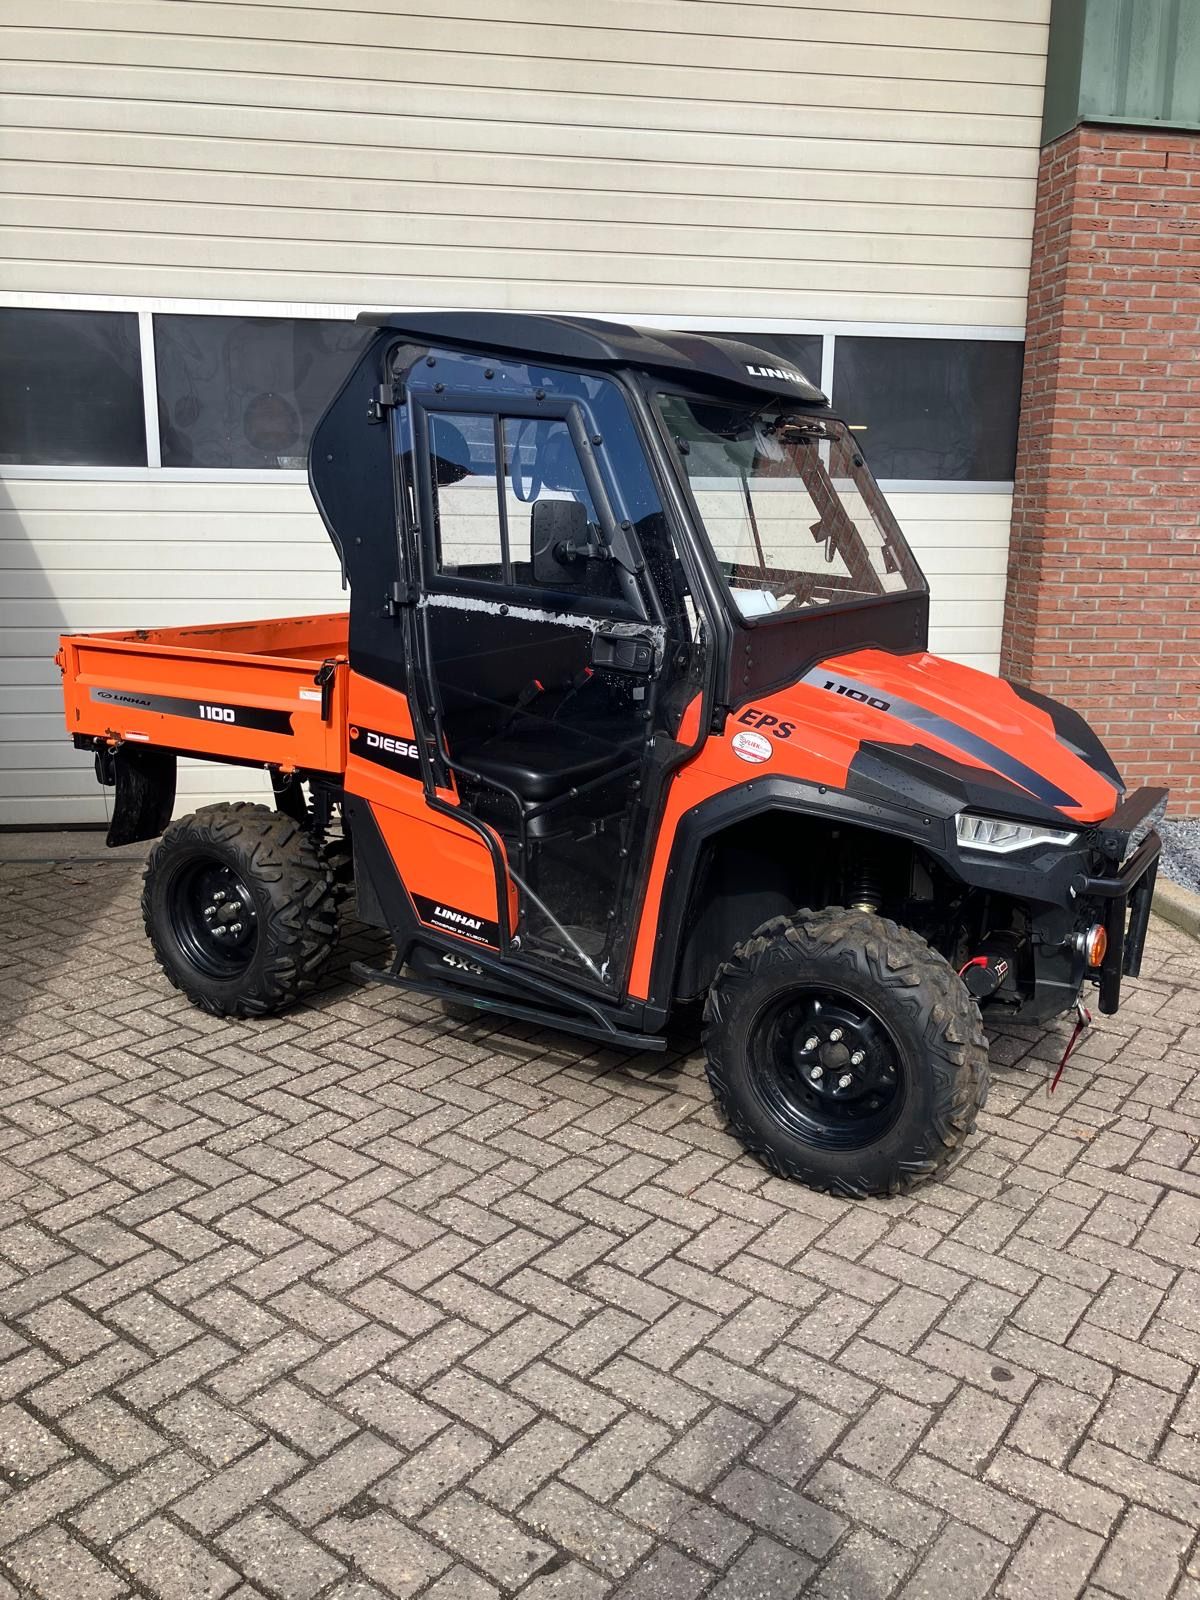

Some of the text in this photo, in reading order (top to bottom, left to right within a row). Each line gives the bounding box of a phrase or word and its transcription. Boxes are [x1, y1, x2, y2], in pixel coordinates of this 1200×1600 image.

[114, 694, 151, 706] LINHAI
[823, 680, 891, 712] 1100
[199, 705, 235, 723] 1100
[737, 708, 797, 739] EPS
[366, 732, 435, 763] DIESE
[434, 906, 481, 930] LINHAI
[430, 919, 457, 932] POWERED
[466, 932, 489, 943] KUBOTA
